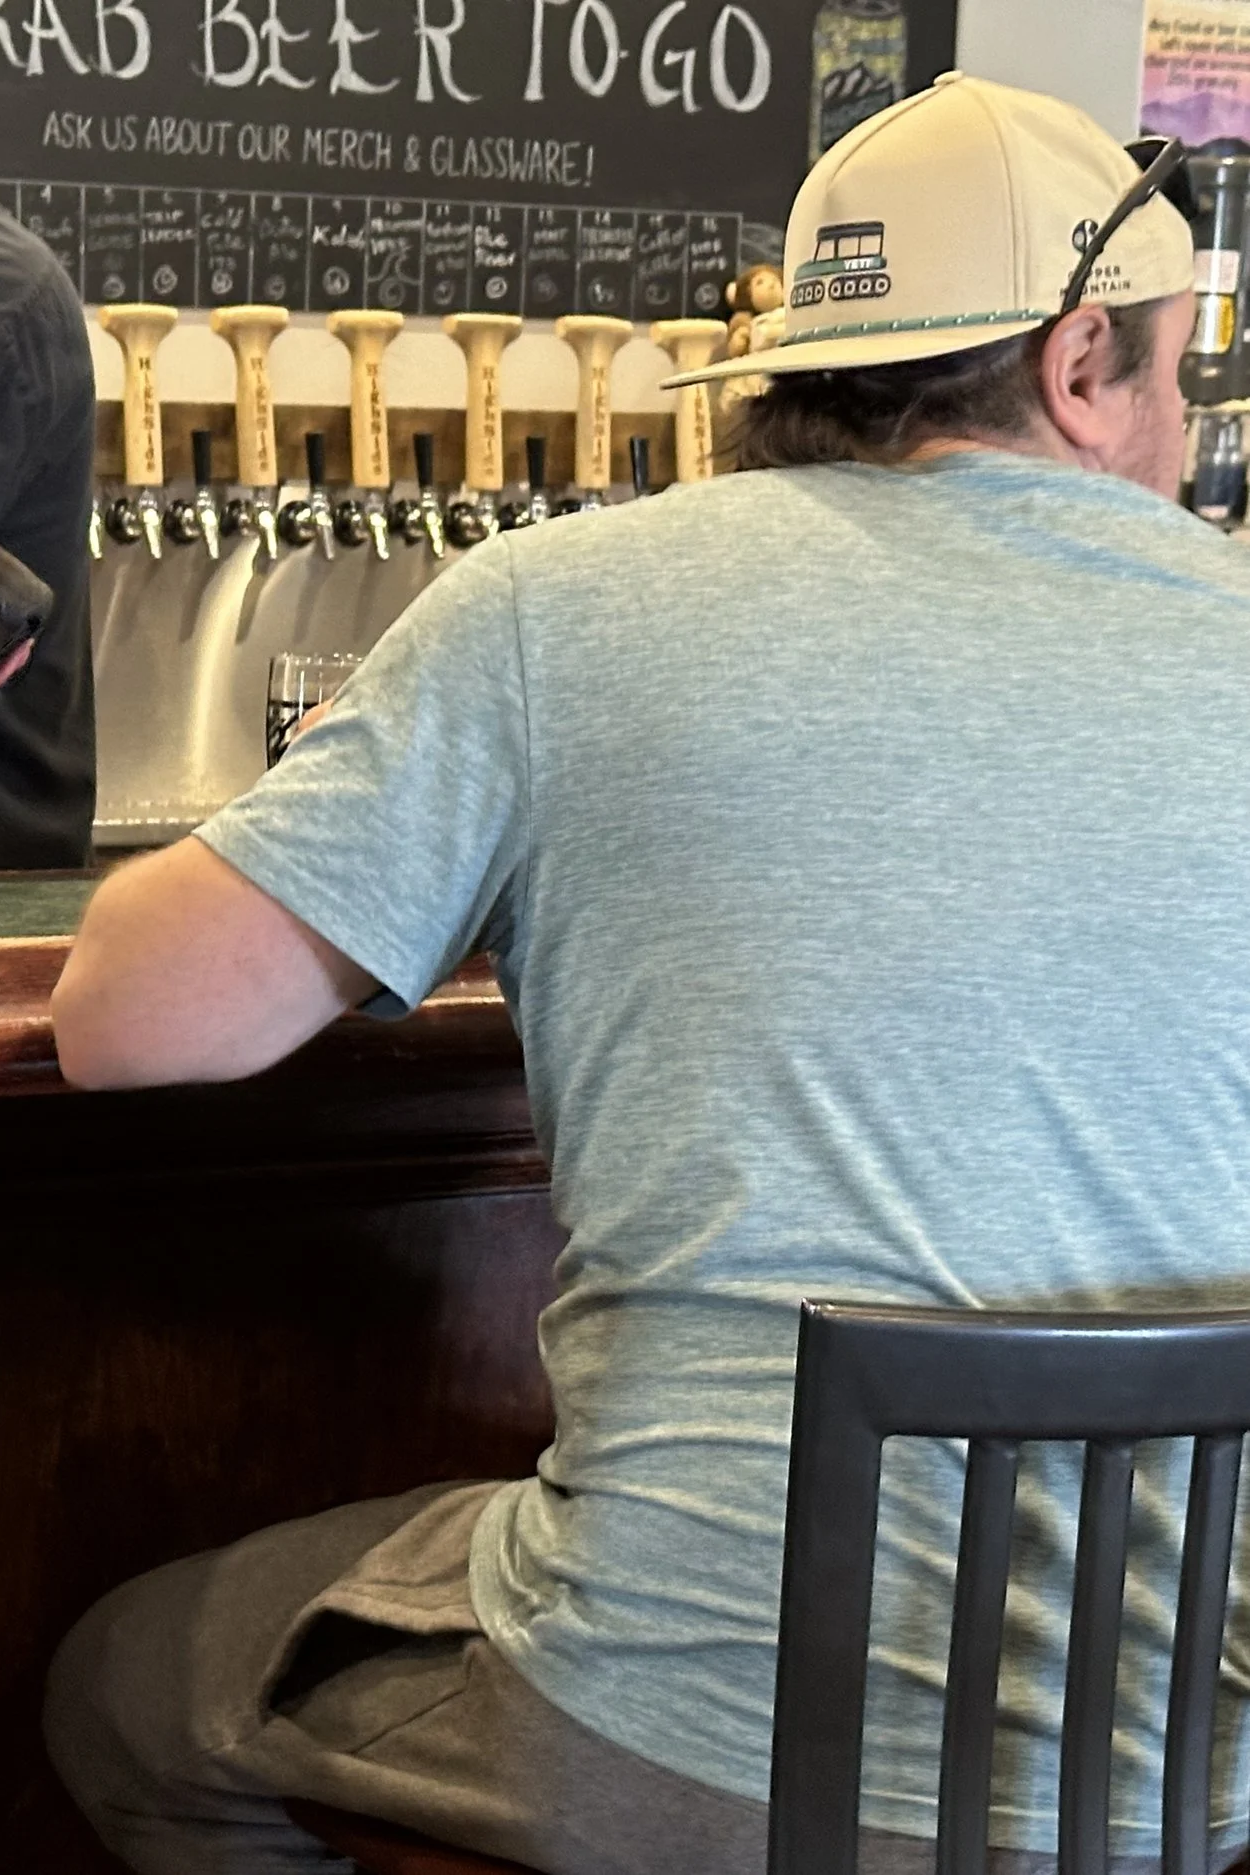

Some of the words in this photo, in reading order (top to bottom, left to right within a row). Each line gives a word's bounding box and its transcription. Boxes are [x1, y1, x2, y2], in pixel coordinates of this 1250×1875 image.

[193, 0, 482, 104] BEER
[43, 111, 94, 149] ASK
[101, 116, 137, 151] US
[145, 116, 233, 156] ABOUT
[238, 123, 292, 162] OUR
[303, 128, 393, 171] MERCH
[403, 136, 422, 174] &
[429, 136, 594, 188] GLASSWARE!
